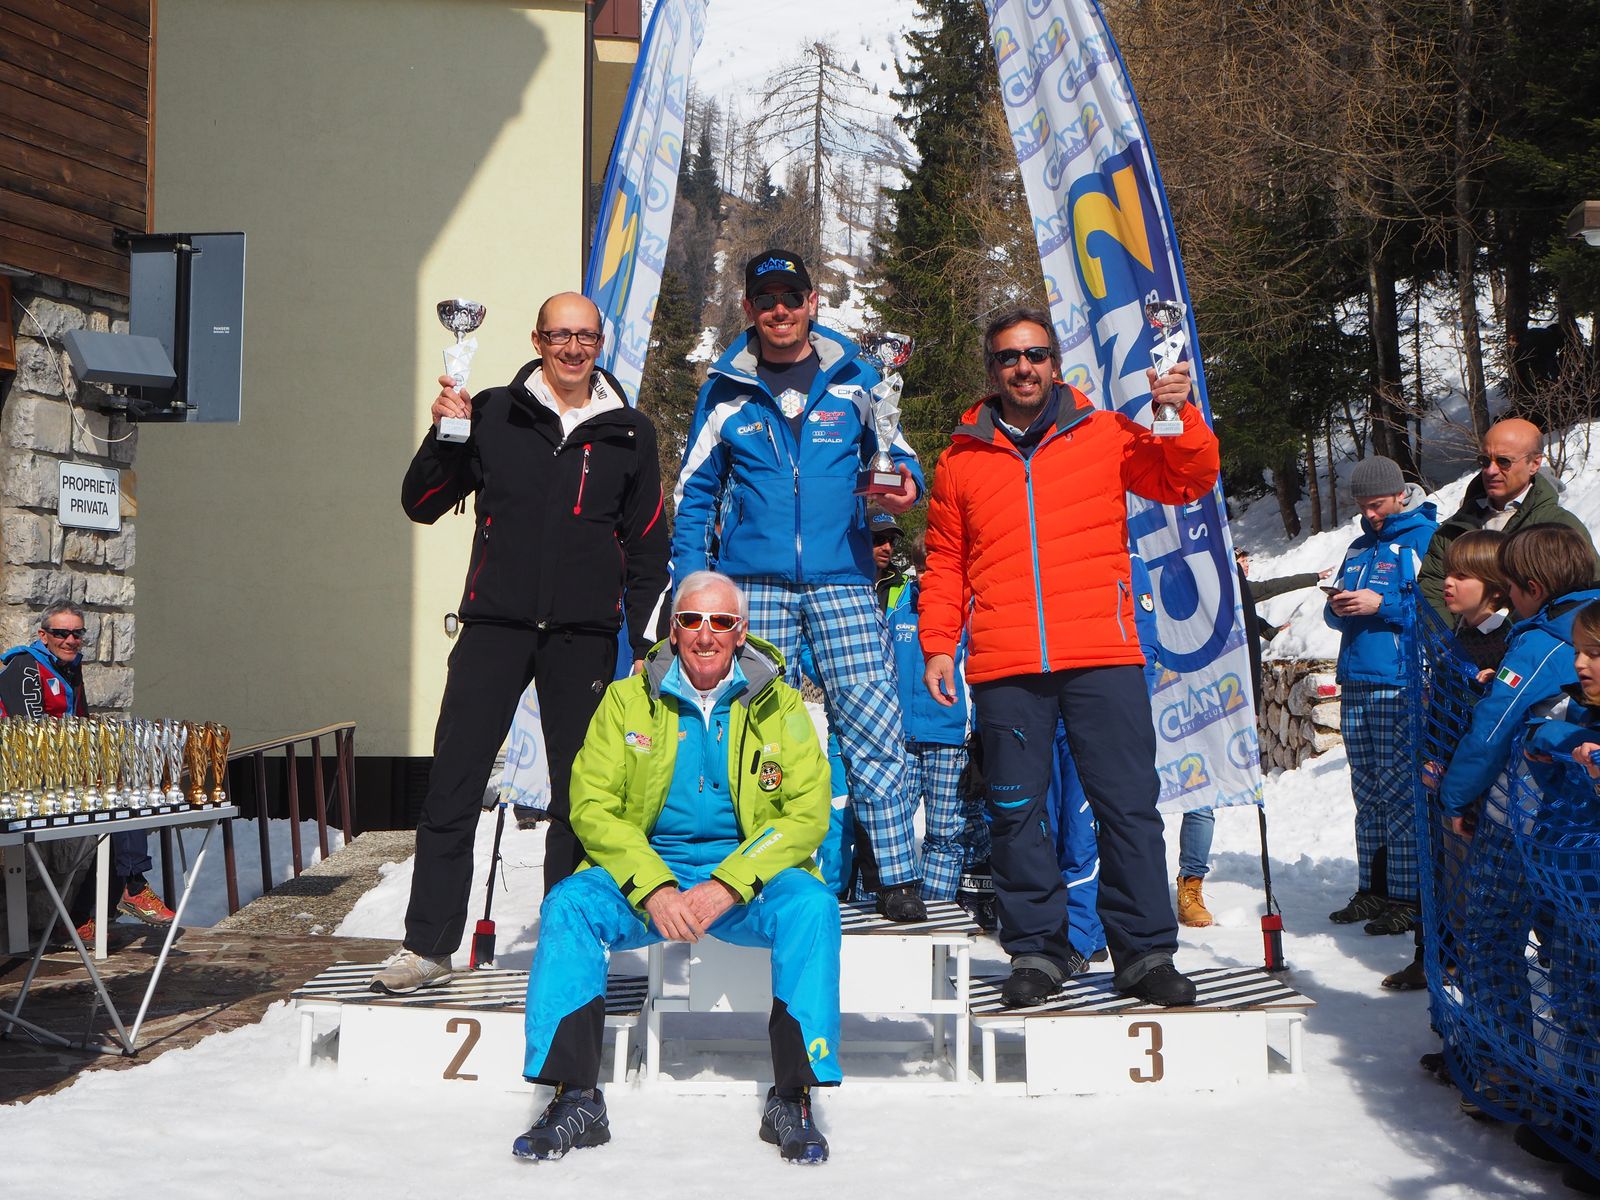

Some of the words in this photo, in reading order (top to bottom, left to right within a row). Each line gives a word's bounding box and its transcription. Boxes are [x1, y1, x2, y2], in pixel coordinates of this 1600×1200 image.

[70, 498, 109, 516] PRIVATA
[1159, 672, 1249, 742] CLAN2
[443, 1017, 481, 1081] 2
[1127, 1021, 1164, 1083] 3
